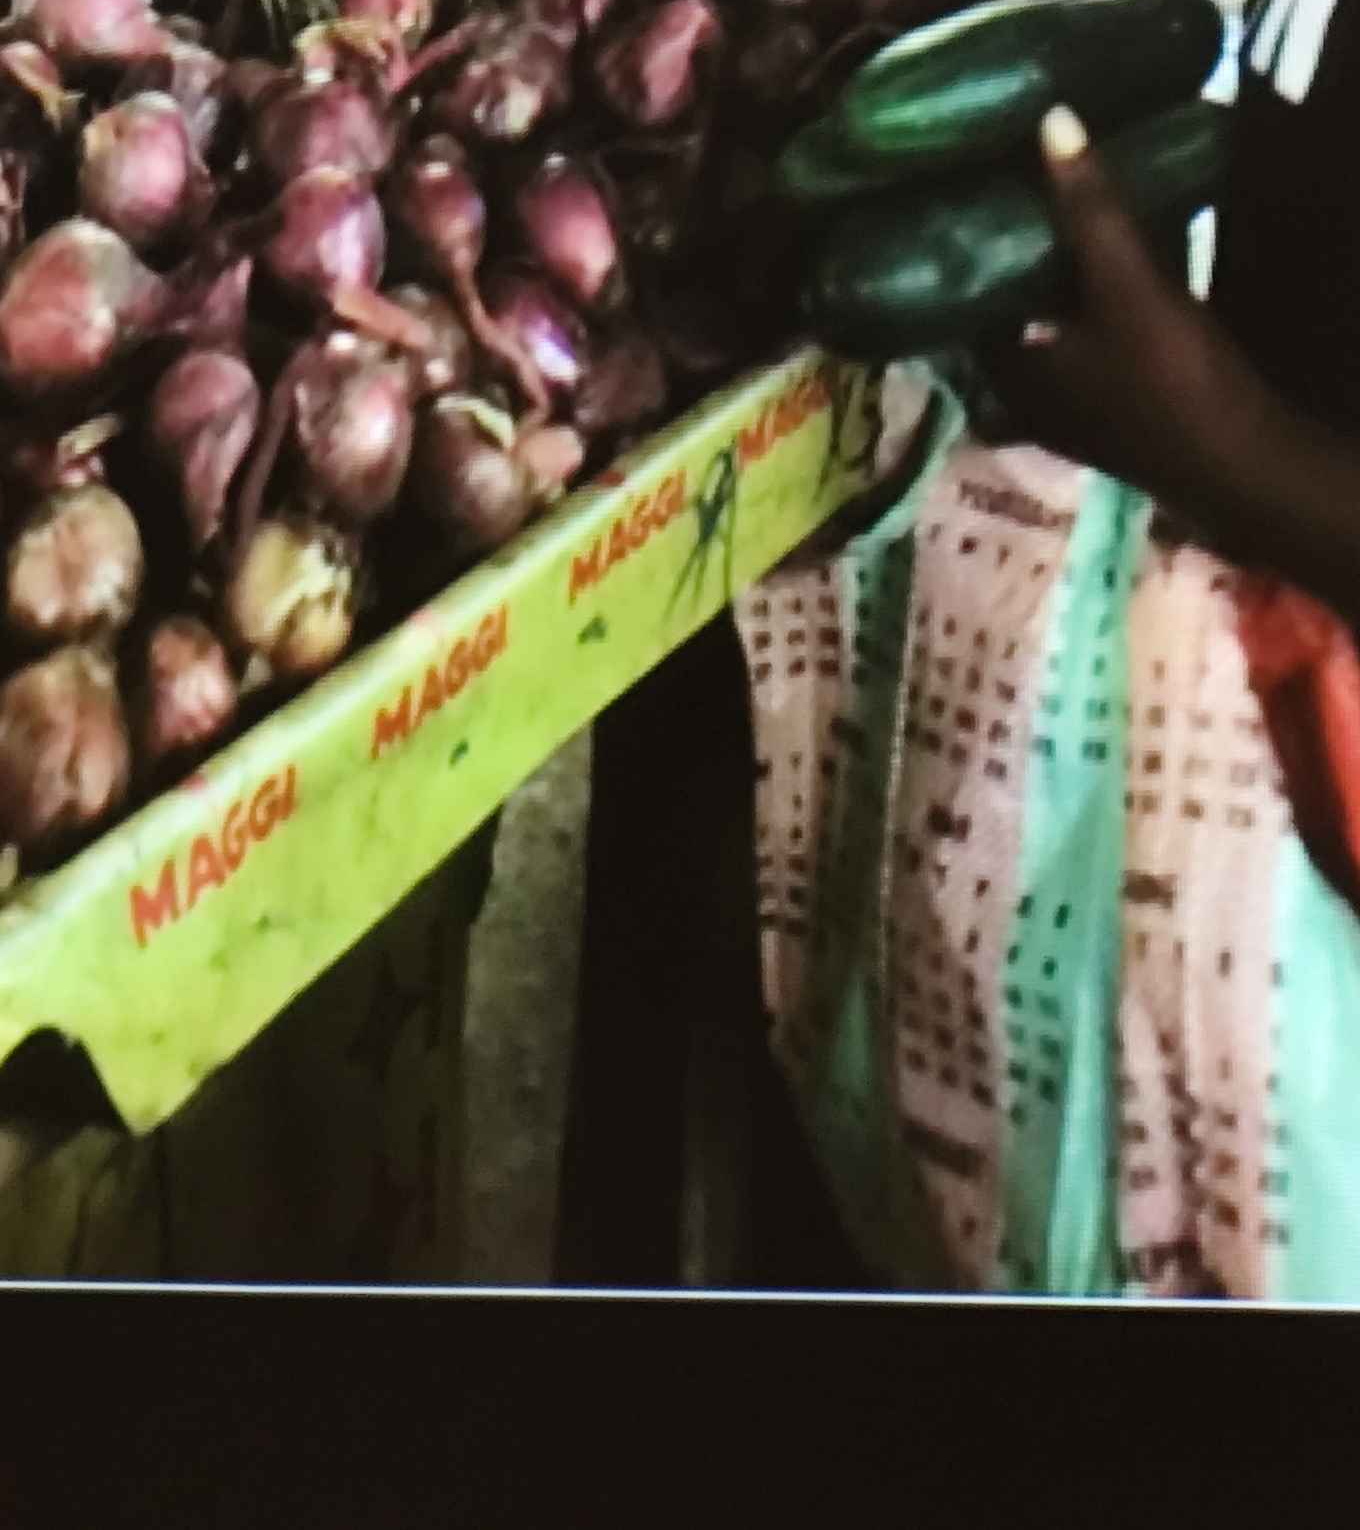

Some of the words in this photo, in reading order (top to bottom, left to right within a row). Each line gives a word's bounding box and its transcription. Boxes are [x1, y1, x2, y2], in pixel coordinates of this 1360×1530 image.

[129, 766, 296, 947] MAGGI
[372, 606, 507, 759] MAGGI
[569, 471, 686, 605] MAGGI
